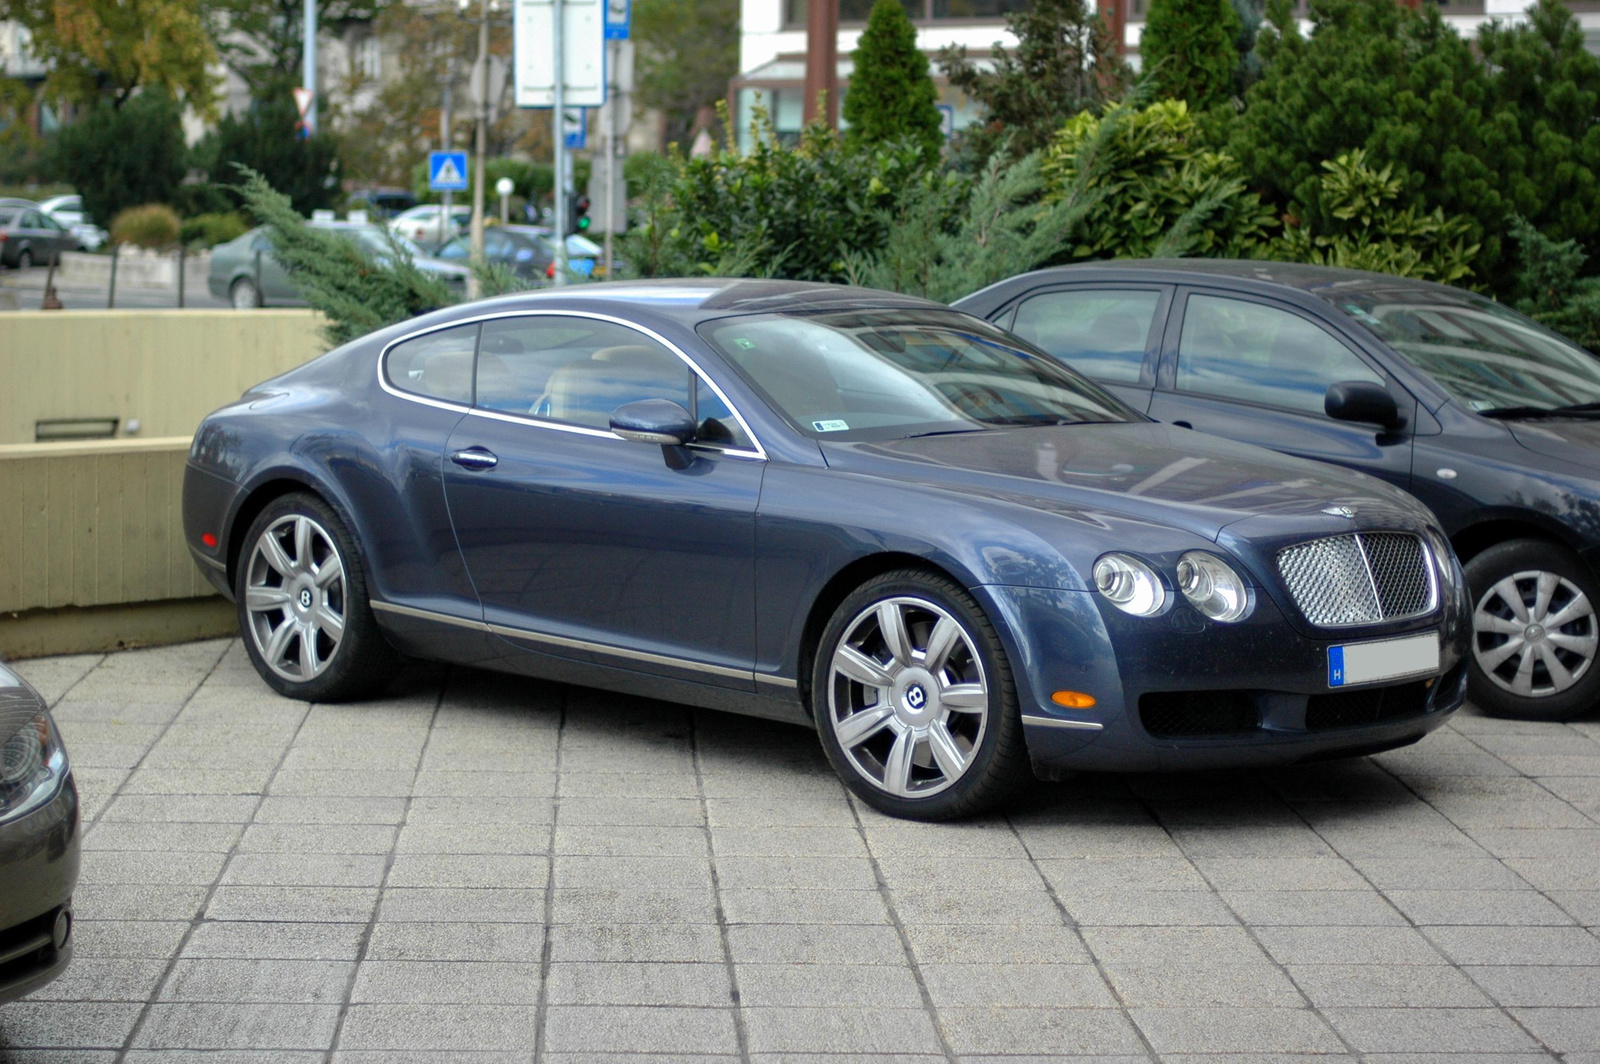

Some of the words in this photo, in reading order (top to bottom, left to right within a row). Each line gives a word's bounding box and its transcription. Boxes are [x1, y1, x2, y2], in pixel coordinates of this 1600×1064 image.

[301, 590, 310, 606] B
[1333, 669, 1341, 680] H
[908, 687, 923, 706] B
